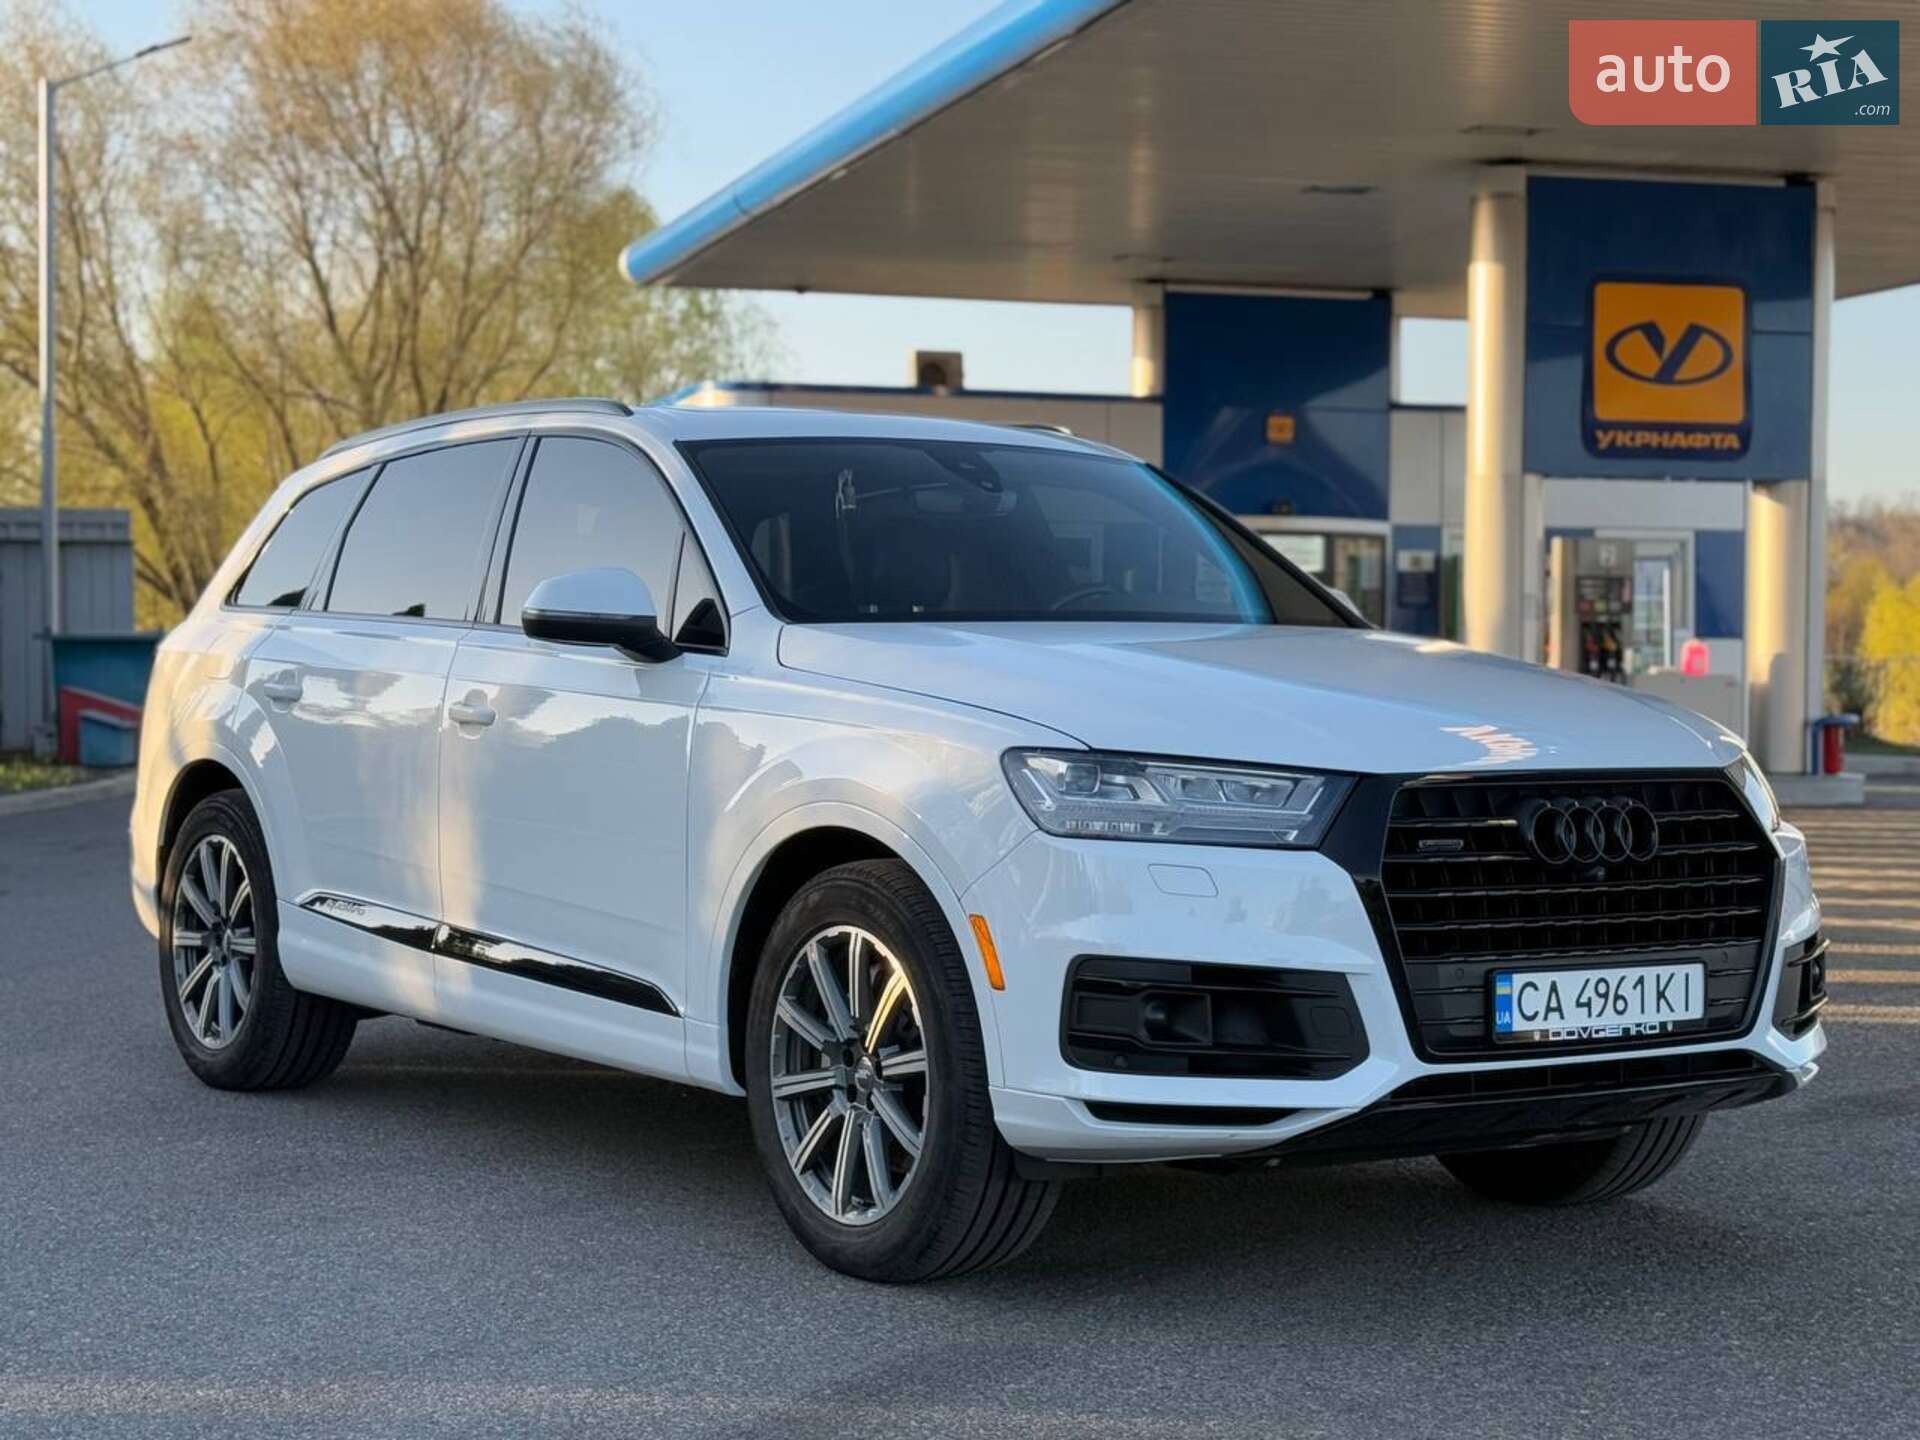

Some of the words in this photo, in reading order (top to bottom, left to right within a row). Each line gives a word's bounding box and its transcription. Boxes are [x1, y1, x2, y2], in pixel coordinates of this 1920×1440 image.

[1594, 429, 1741, 449] УКРНАФТА
[1517, 980, 1565, 1022] CA
[1495, 1011, 1512, 1026] UA
